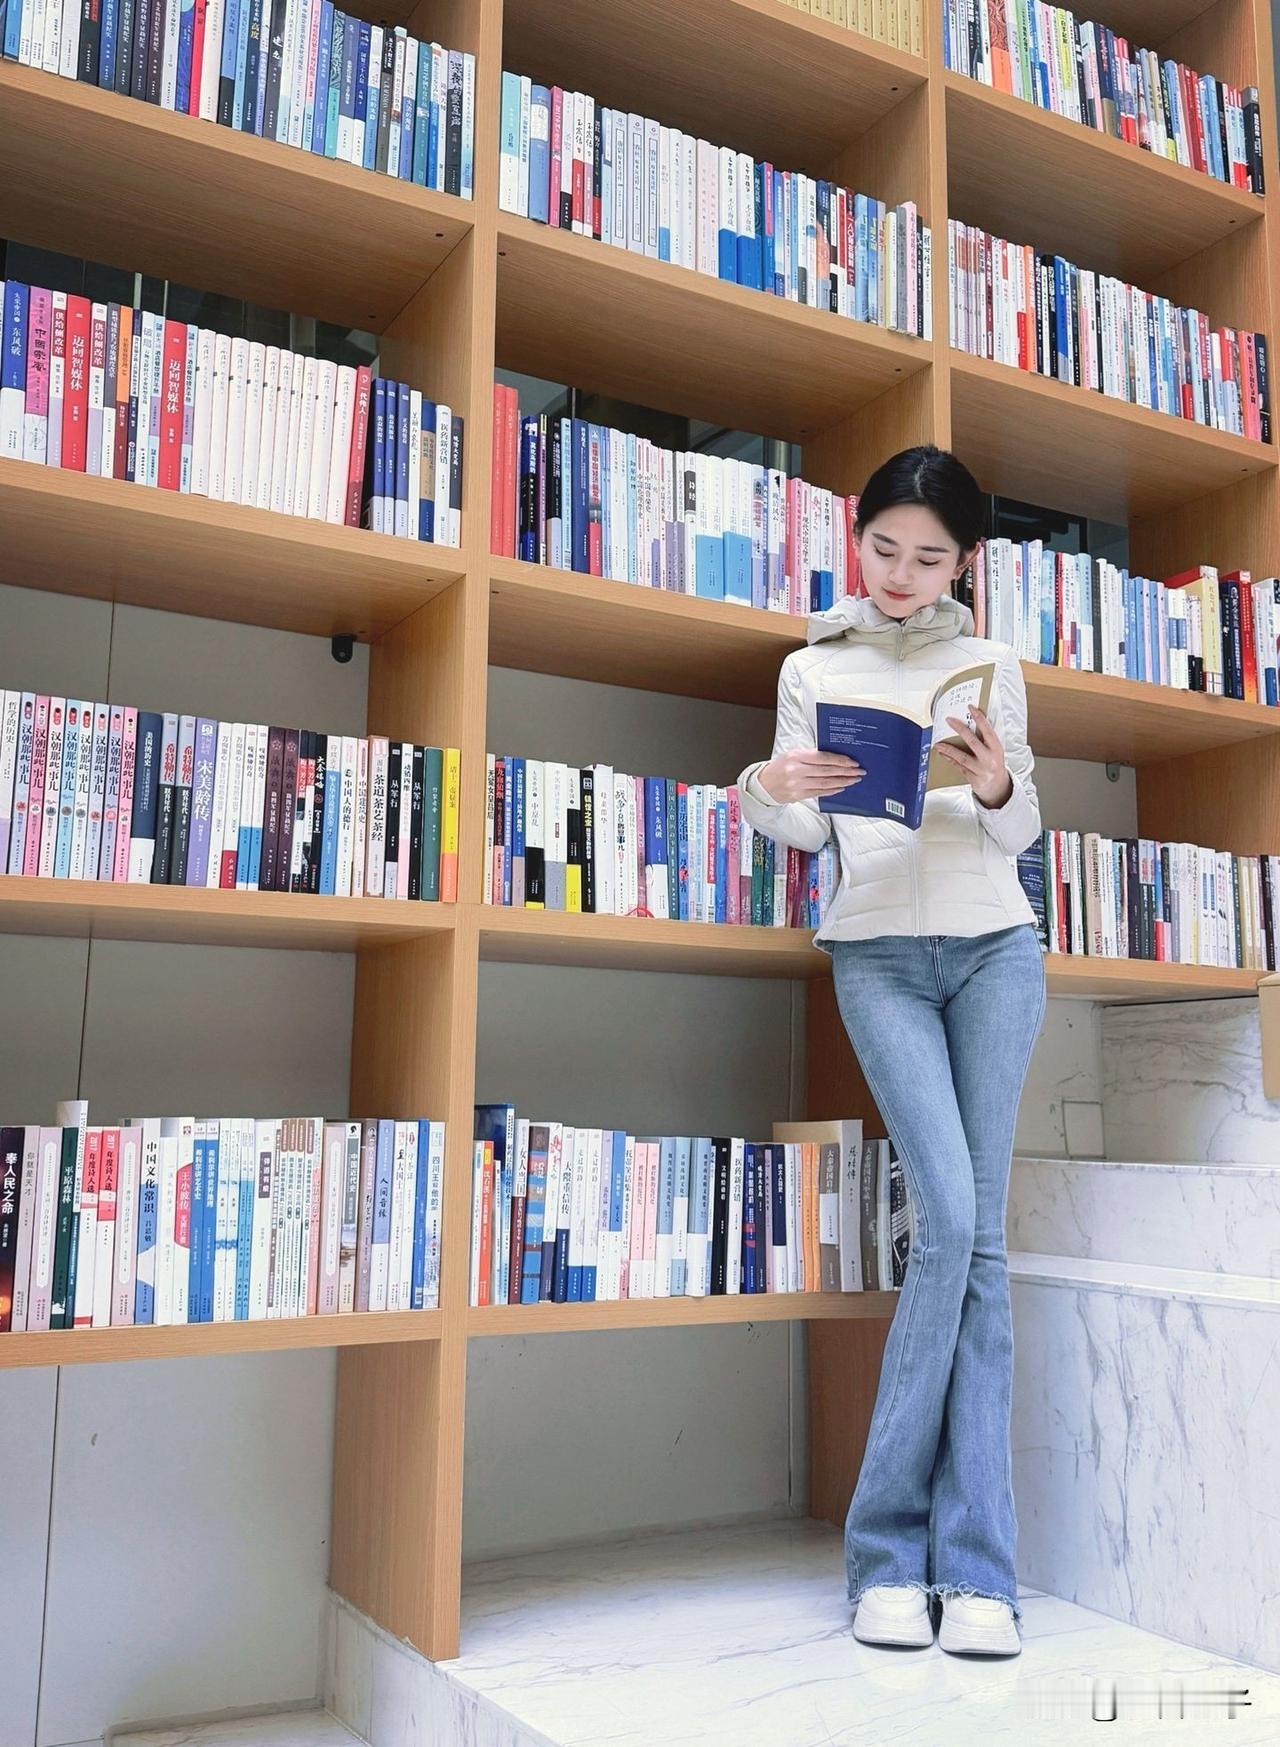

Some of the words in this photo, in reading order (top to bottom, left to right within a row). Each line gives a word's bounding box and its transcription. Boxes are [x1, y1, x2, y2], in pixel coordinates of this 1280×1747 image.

[193, 759, 214, 822] 宋美龄传
[371, 774, 386, 842] 茶道茶艺茶经
[2, 1152, 18, 1215] 奉人民之命
[144, 1141, 158, 1214] 中国文化常识
